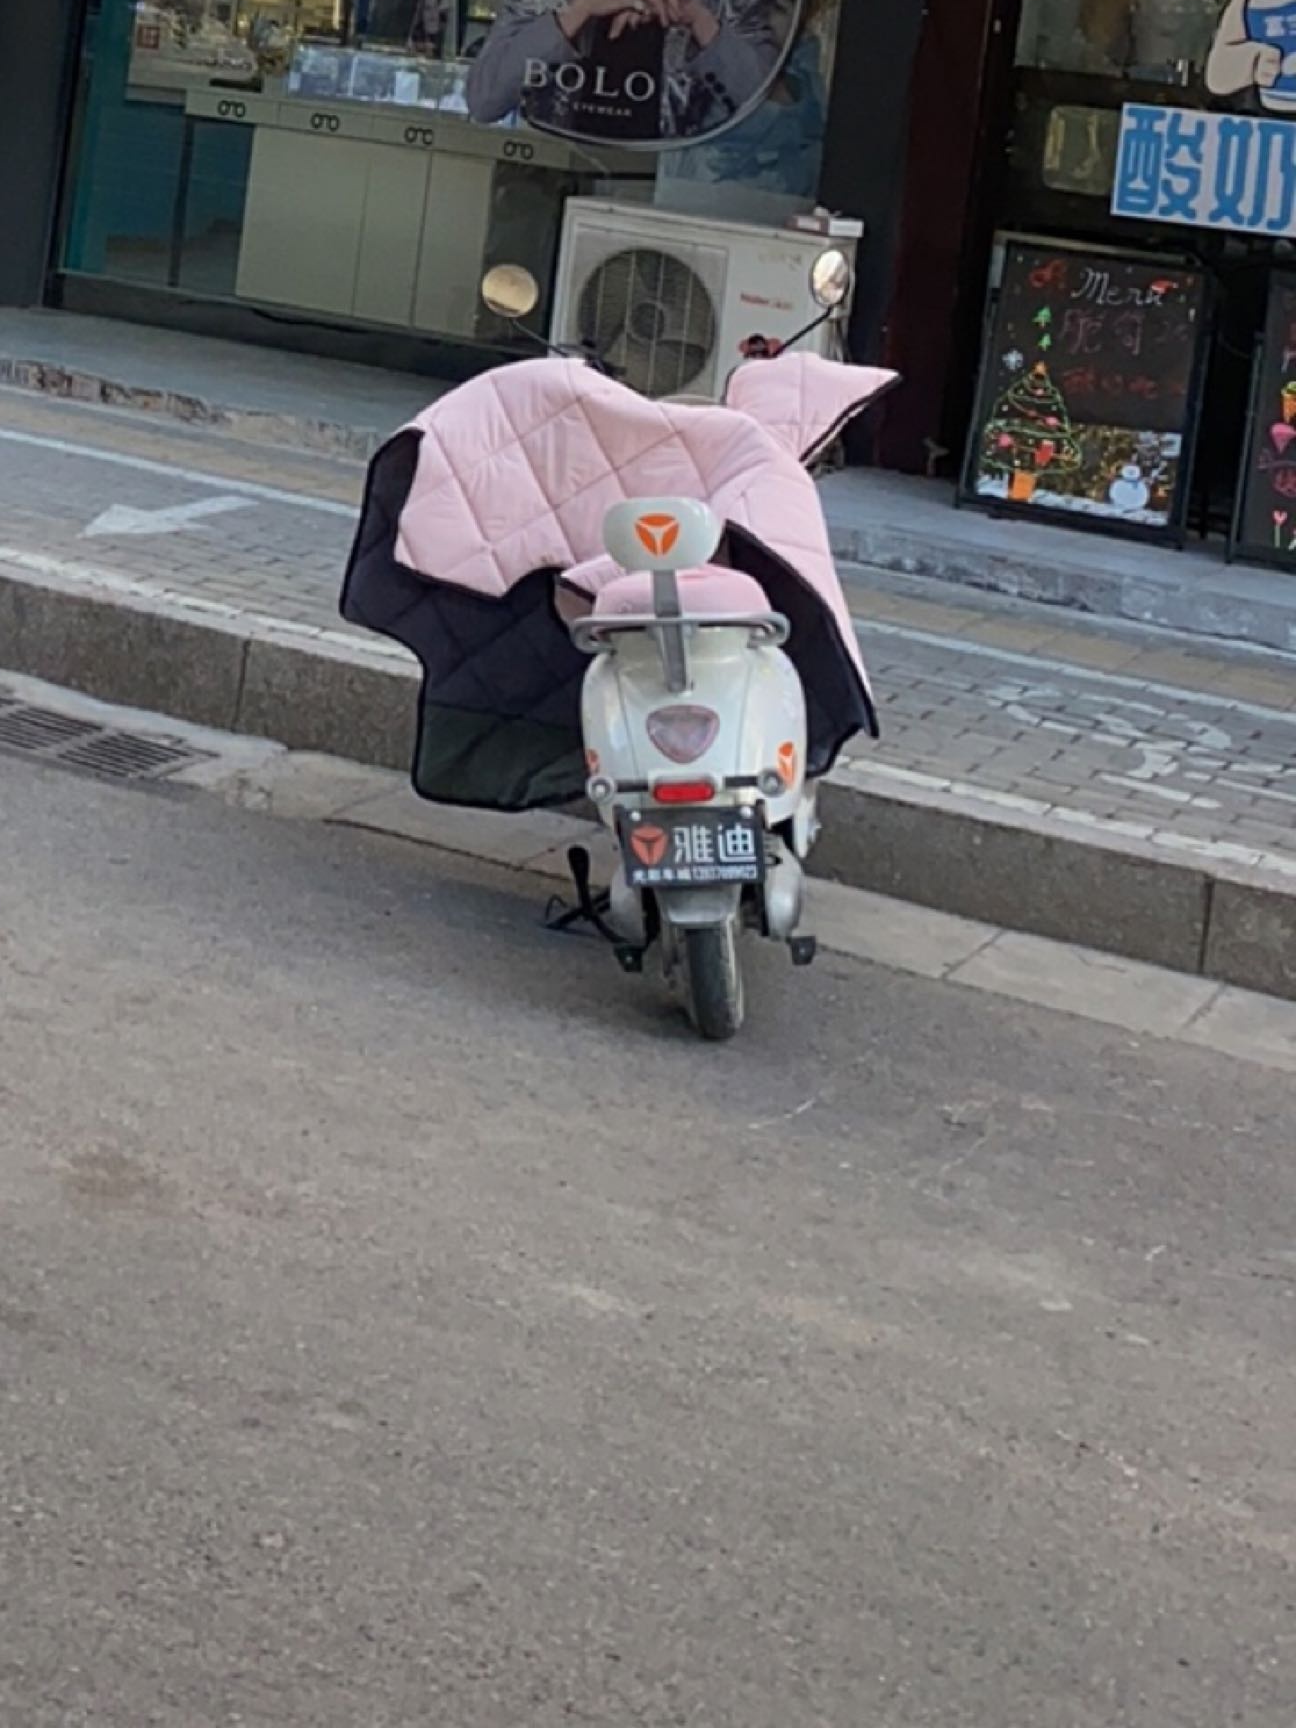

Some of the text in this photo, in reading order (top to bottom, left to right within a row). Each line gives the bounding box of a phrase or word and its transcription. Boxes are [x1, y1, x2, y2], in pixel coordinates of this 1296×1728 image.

[523, 57, 693, 110] BOLON
[1115, 106, 1296, 231] 酸奶
[671, 822, 757, 864] 雅迪
